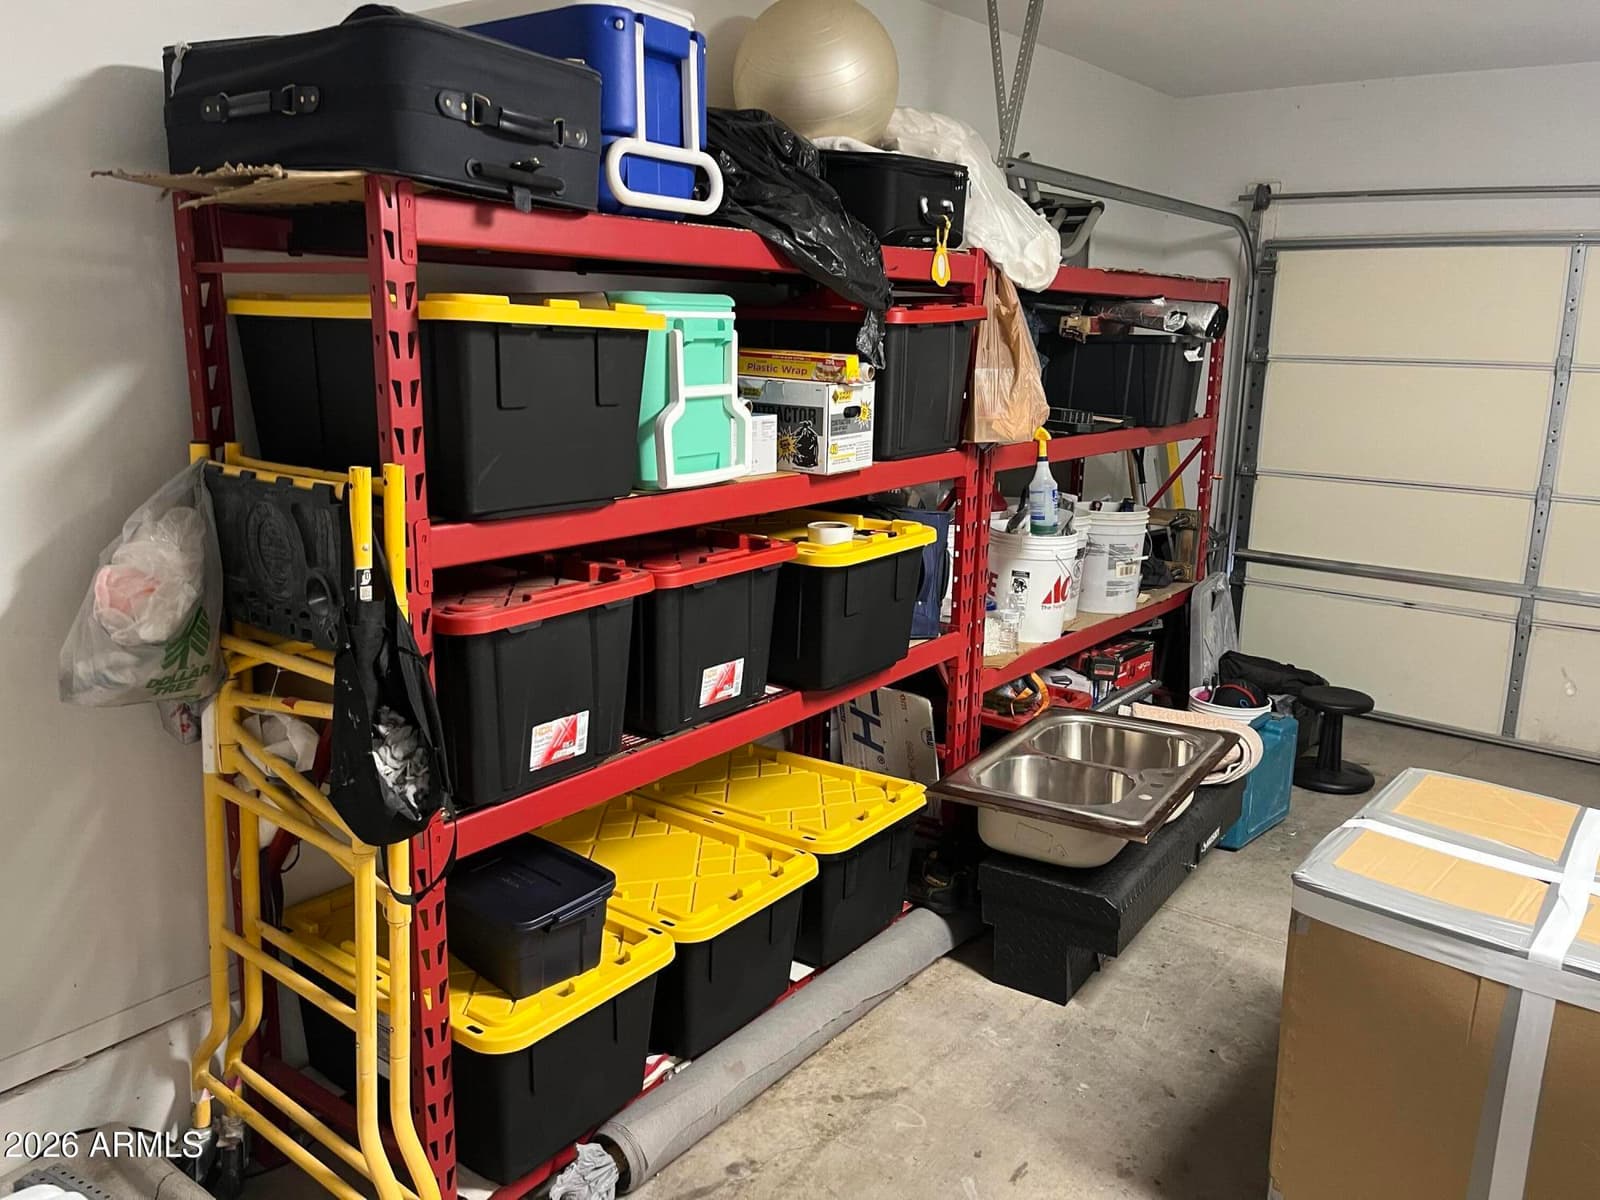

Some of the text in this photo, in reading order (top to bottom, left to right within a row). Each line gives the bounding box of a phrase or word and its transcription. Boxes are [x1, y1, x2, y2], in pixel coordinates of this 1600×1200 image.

[747, 362, 808, 376] Plastic Wrap
[755, 404, 816, 424] TRACTOR
[1042, 576, 1071, 604] AC
[146, 664, 210, 688] DOLLAR
[153, 682, 194, 695] TREE
